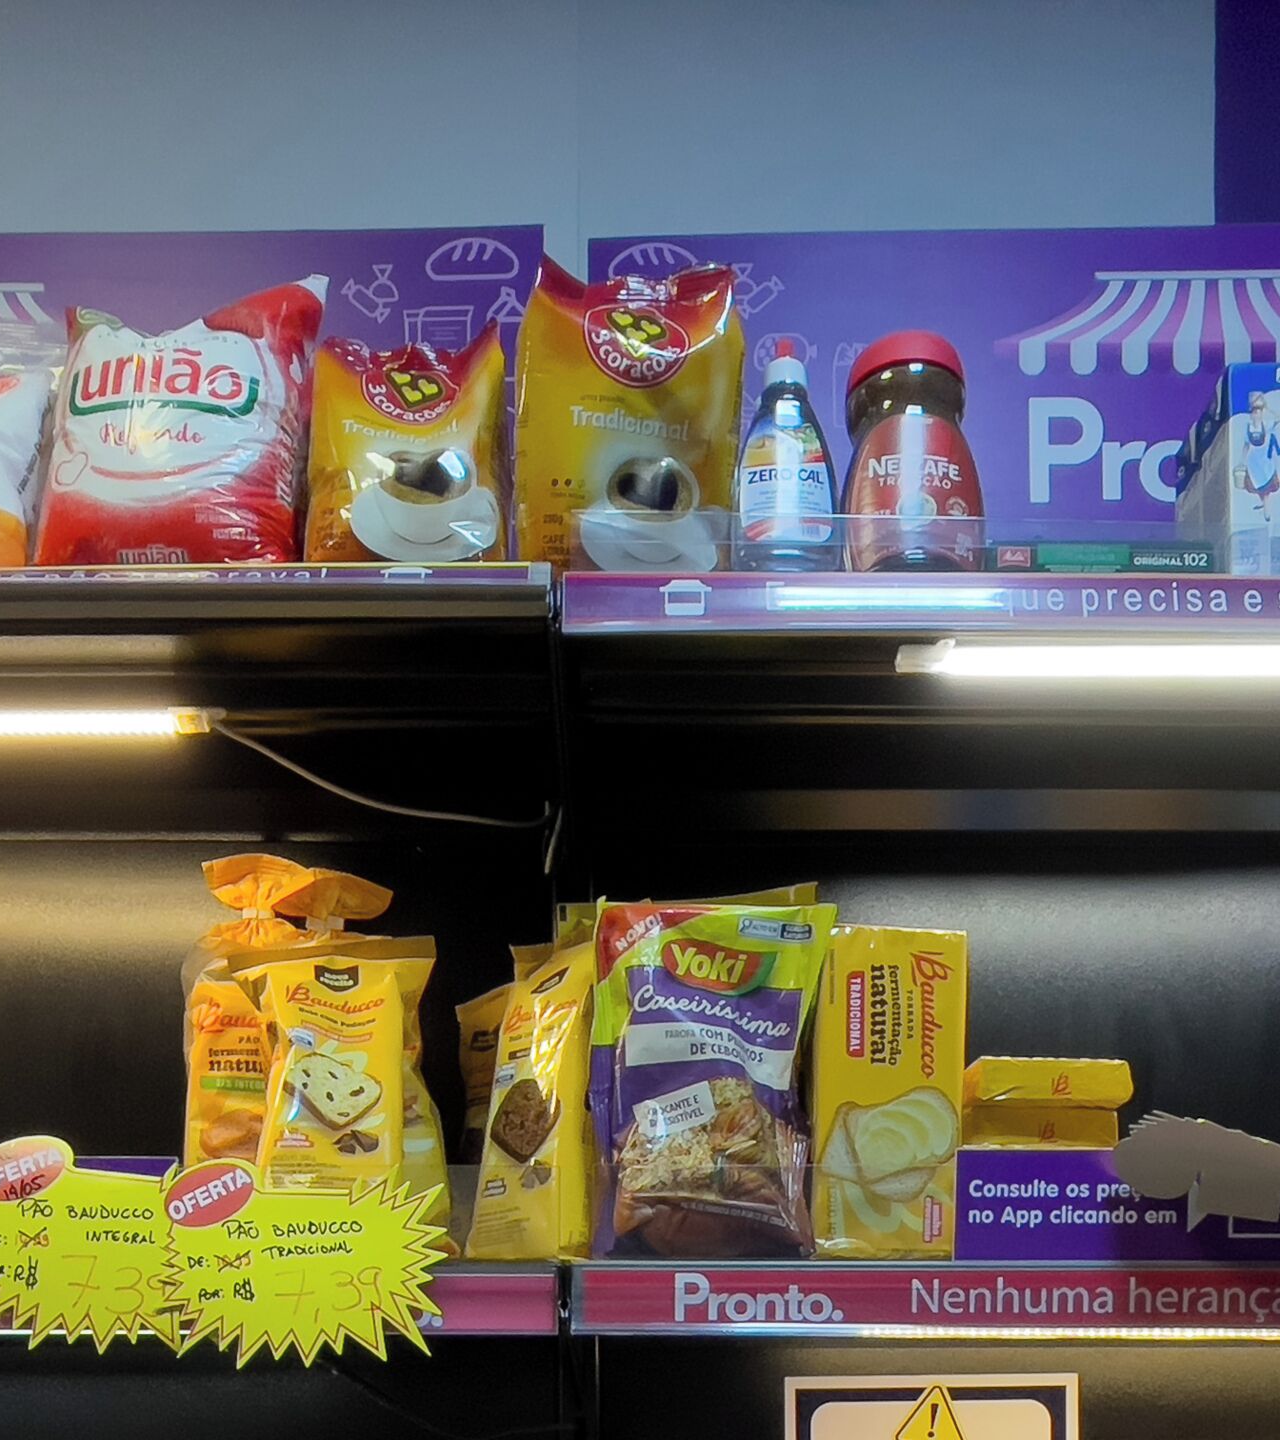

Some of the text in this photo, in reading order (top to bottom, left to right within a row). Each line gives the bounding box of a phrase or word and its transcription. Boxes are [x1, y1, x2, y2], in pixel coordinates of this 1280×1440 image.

[81, 348, 243, 401] união
[569, 405, 690, 442] Tradicional
[1082, 581, 1230, 619] precisa
[1242, 588, 1263, 611] e
[669, 943, 746, 984] Yoki
[286, 983, 386, 1015] Bauducco
[633, 985, 792, 1038] Caseiríssima
[869, 963, 888, 1066] natural
[910, 950, 956, 1081] Bauducco
[168, 1165, 253, 1222] OFERTA
[968, 1178, 1061, 1200] Consulte
[1065, 1182, 1090, 1199] os
[18, 1198, 154, 1221] PÃO BAUDUCCO
[968, 1204, 1178, 1229] no App clicando em
[85, 1230, 157, 1245] INTEGRAL
[221, 1219, 363, 1240] PÃO BAUDUCCO
[187, 1255, 210, 1269] DE:
[261, 1241, 353, 1260] TRADICIONAL
[674, 1272, 845, 1323] Pronto.
[910, 1278, 1115, 1316] Nenhuma
